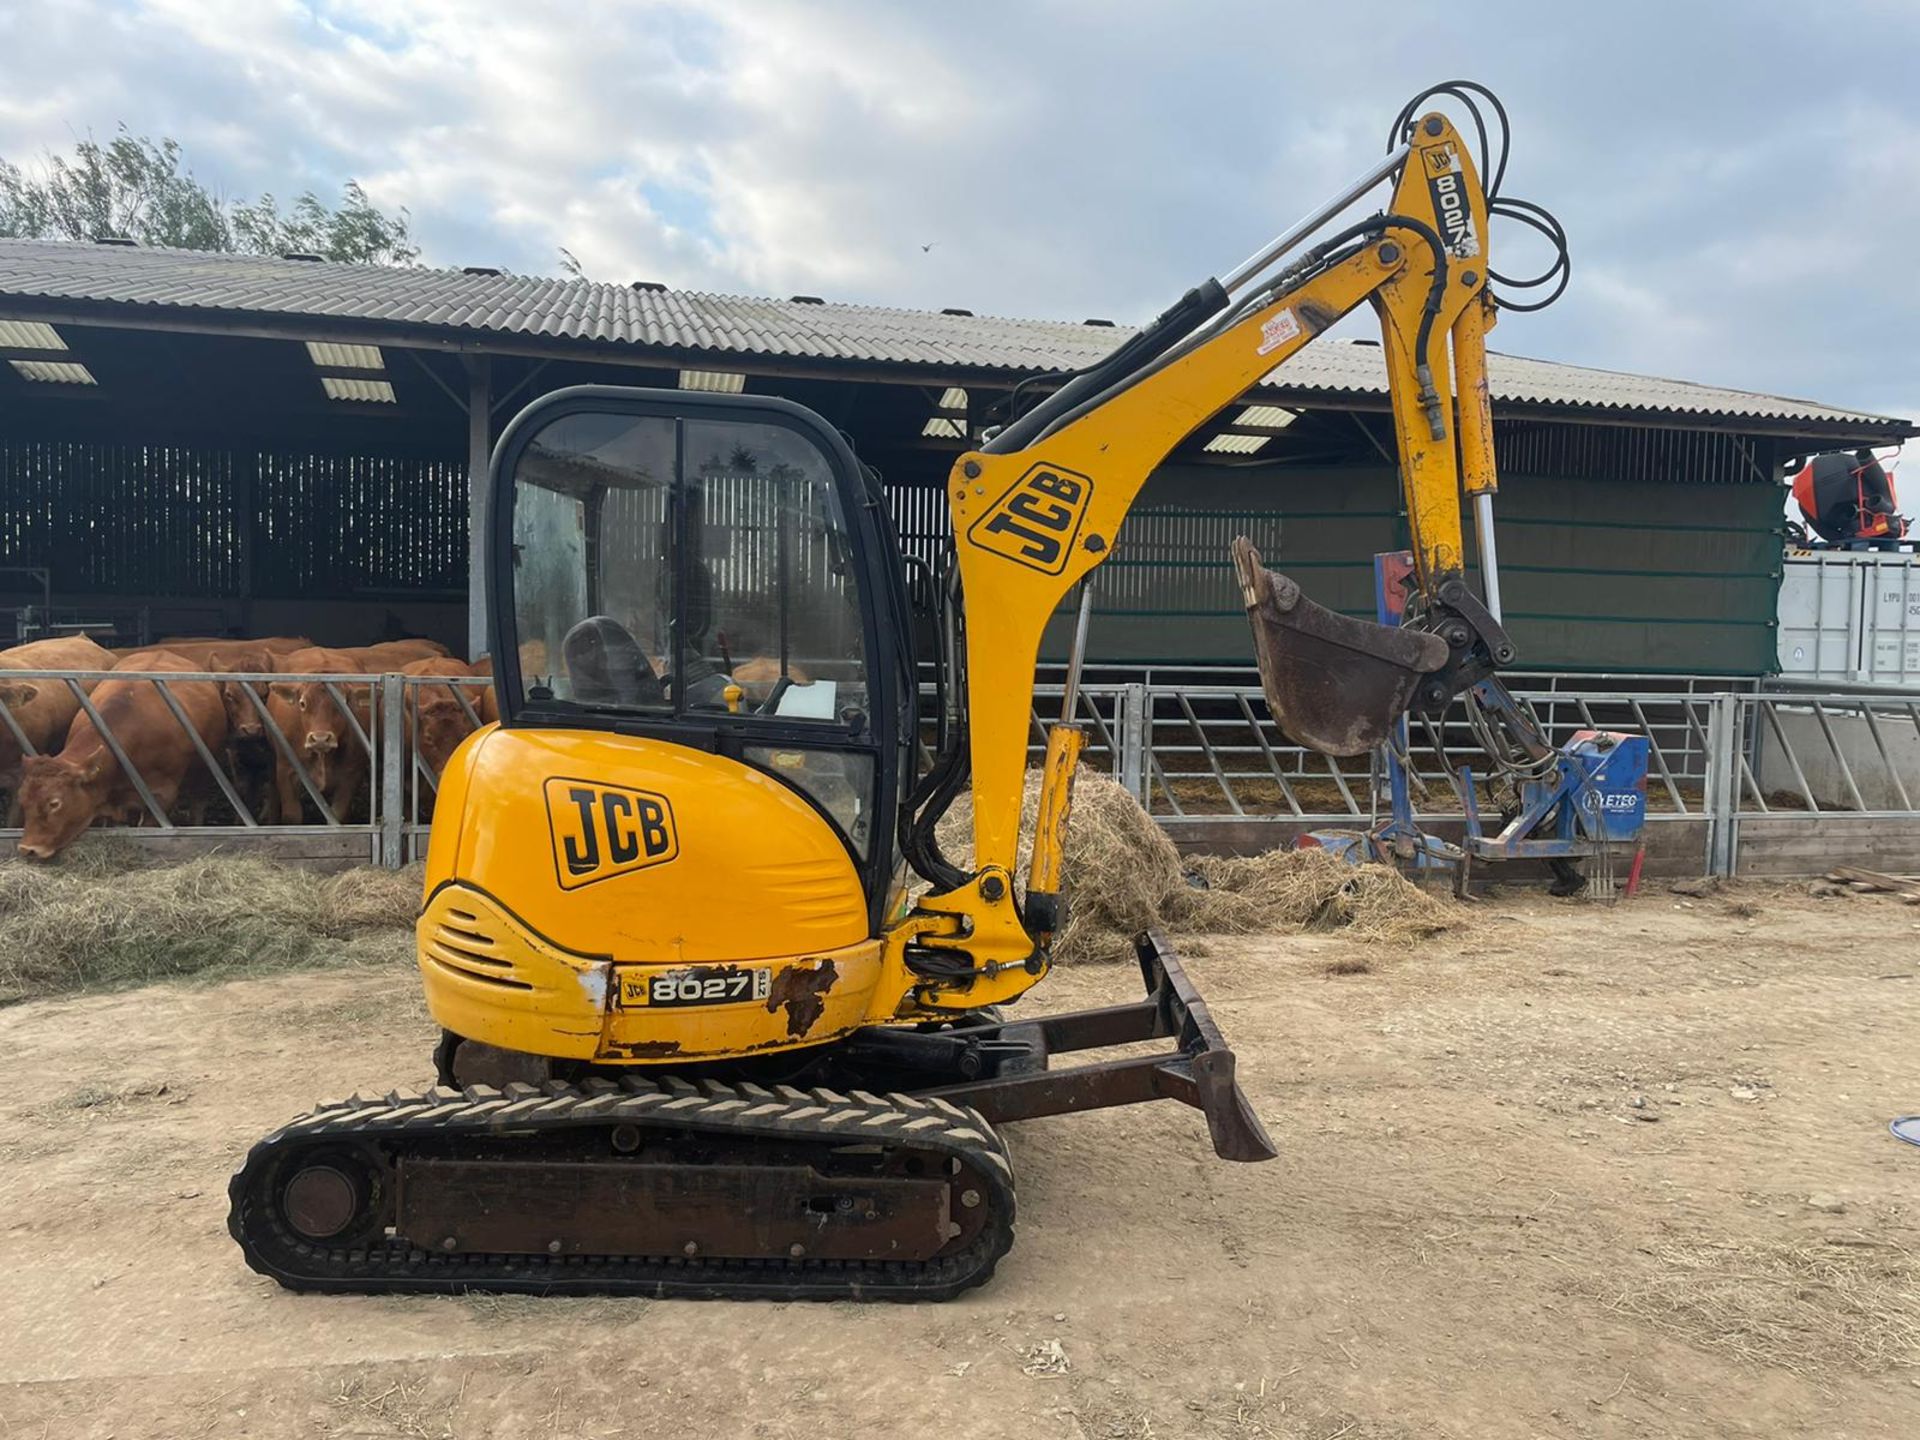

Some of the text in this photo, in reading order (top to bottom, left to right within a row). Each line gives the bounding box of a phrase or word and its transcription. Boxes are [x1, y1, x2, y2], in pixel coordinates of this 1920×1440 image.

[1437, 175, 1466, 244] 8027
[985, 471, 1082, 564] JCB
[564, 787, 669, 875] JCB
[653, 976, 749, 1001] 8027
